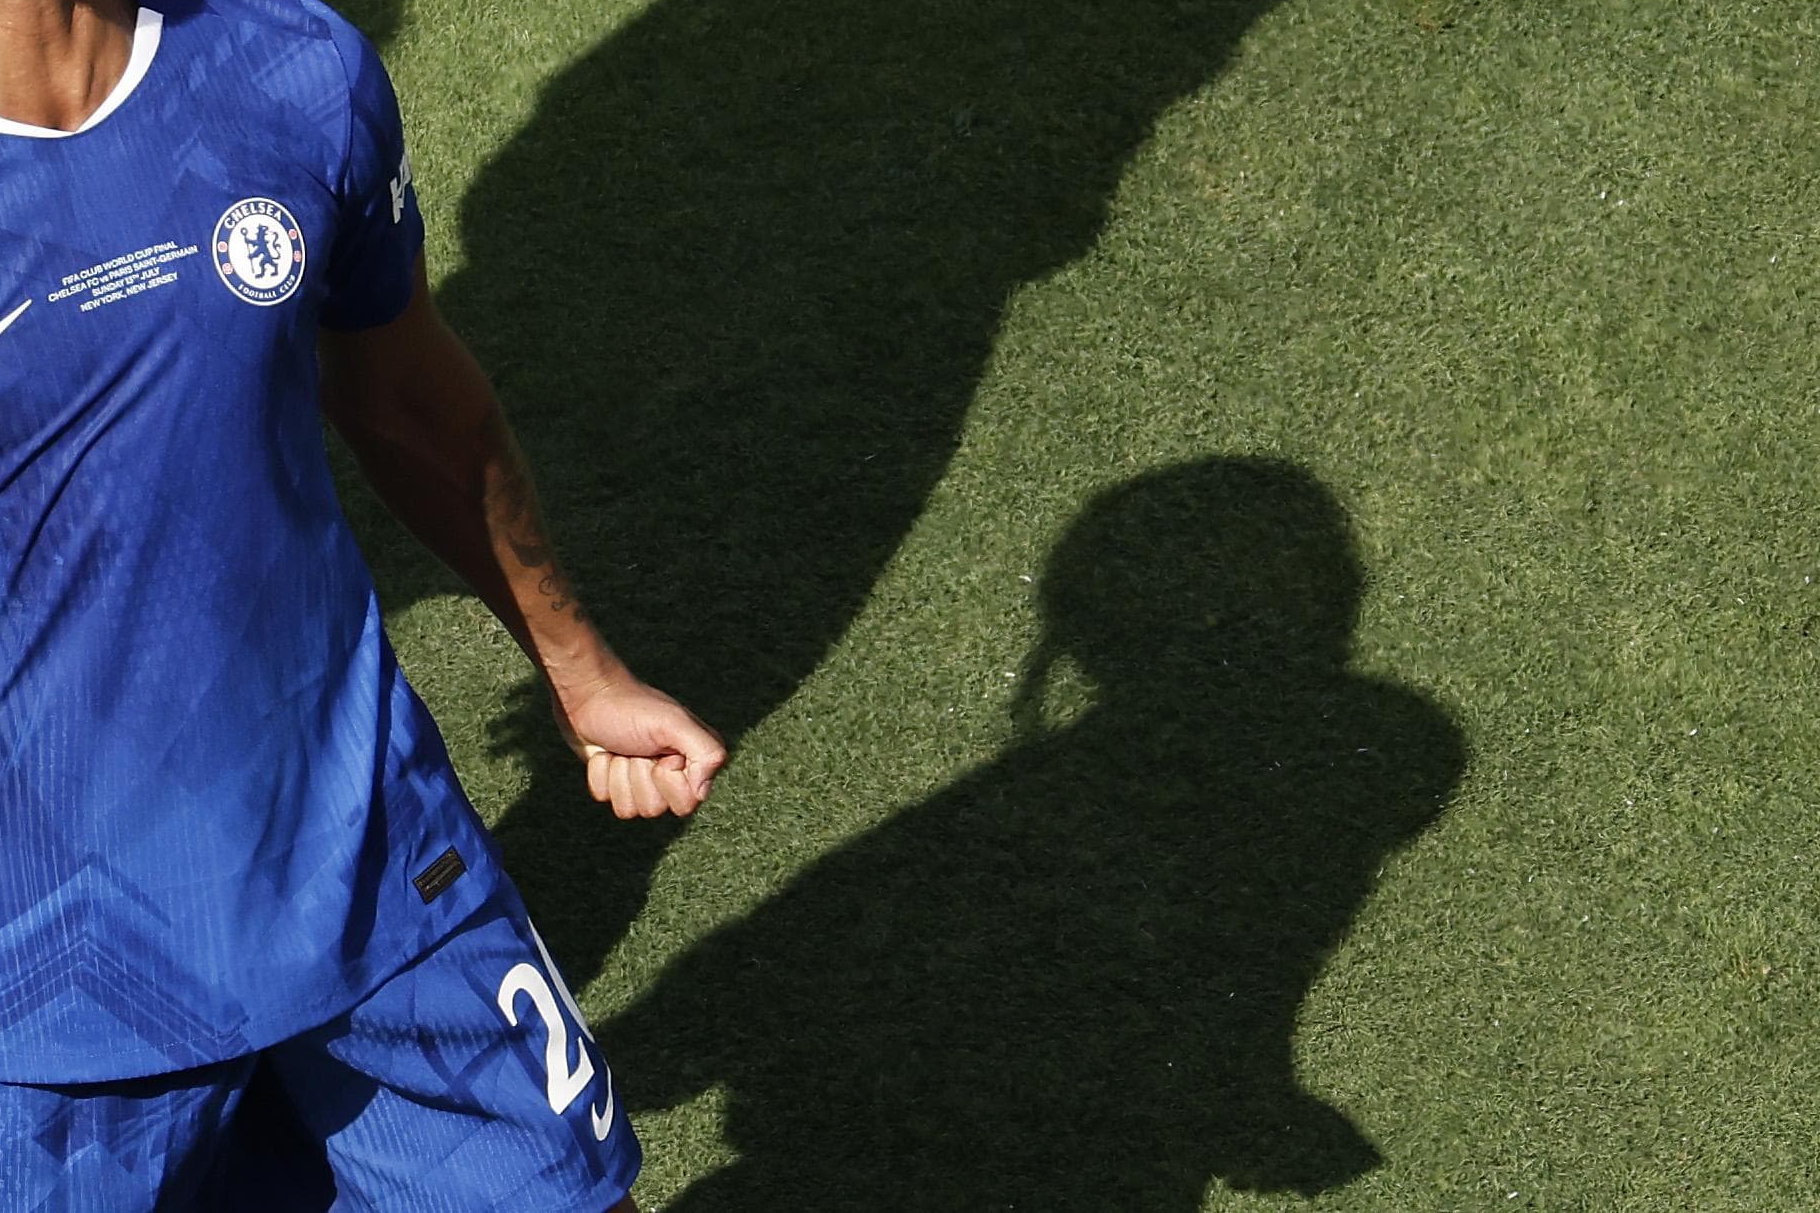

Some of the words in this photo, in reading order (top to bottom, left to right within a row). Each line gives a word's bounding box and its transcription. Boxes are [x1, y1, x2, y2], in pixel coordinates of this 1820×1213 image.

[224, 202, 282, 228] CHELSEA
[48, 282, 86, 302] CHELSEA
[86, 278, 99, 288] FC
[108, 266, 133, 280] PARIS
[132, 244, 198, 273] SAINT-GERMAIN
[62, 274, 80, 286] FIFA
[80, 264, 104, 280] CLUB
[103, 254, 135, 272] WORLD
[135, 248, 154, 260] CUP
[154, 240, 178, 254] FINAL
[80, 298, 100, 312] NEW
[127, 282, 147, 295] NEW
[147, 272, 178, 288] JERSEY
[92, 280, 124, 296] SUNDAY
[140, 266, 160, 280] JULY
[238, 284, 277, 298] FOOTBALL
[280, 274, 296, 293] CLUB
